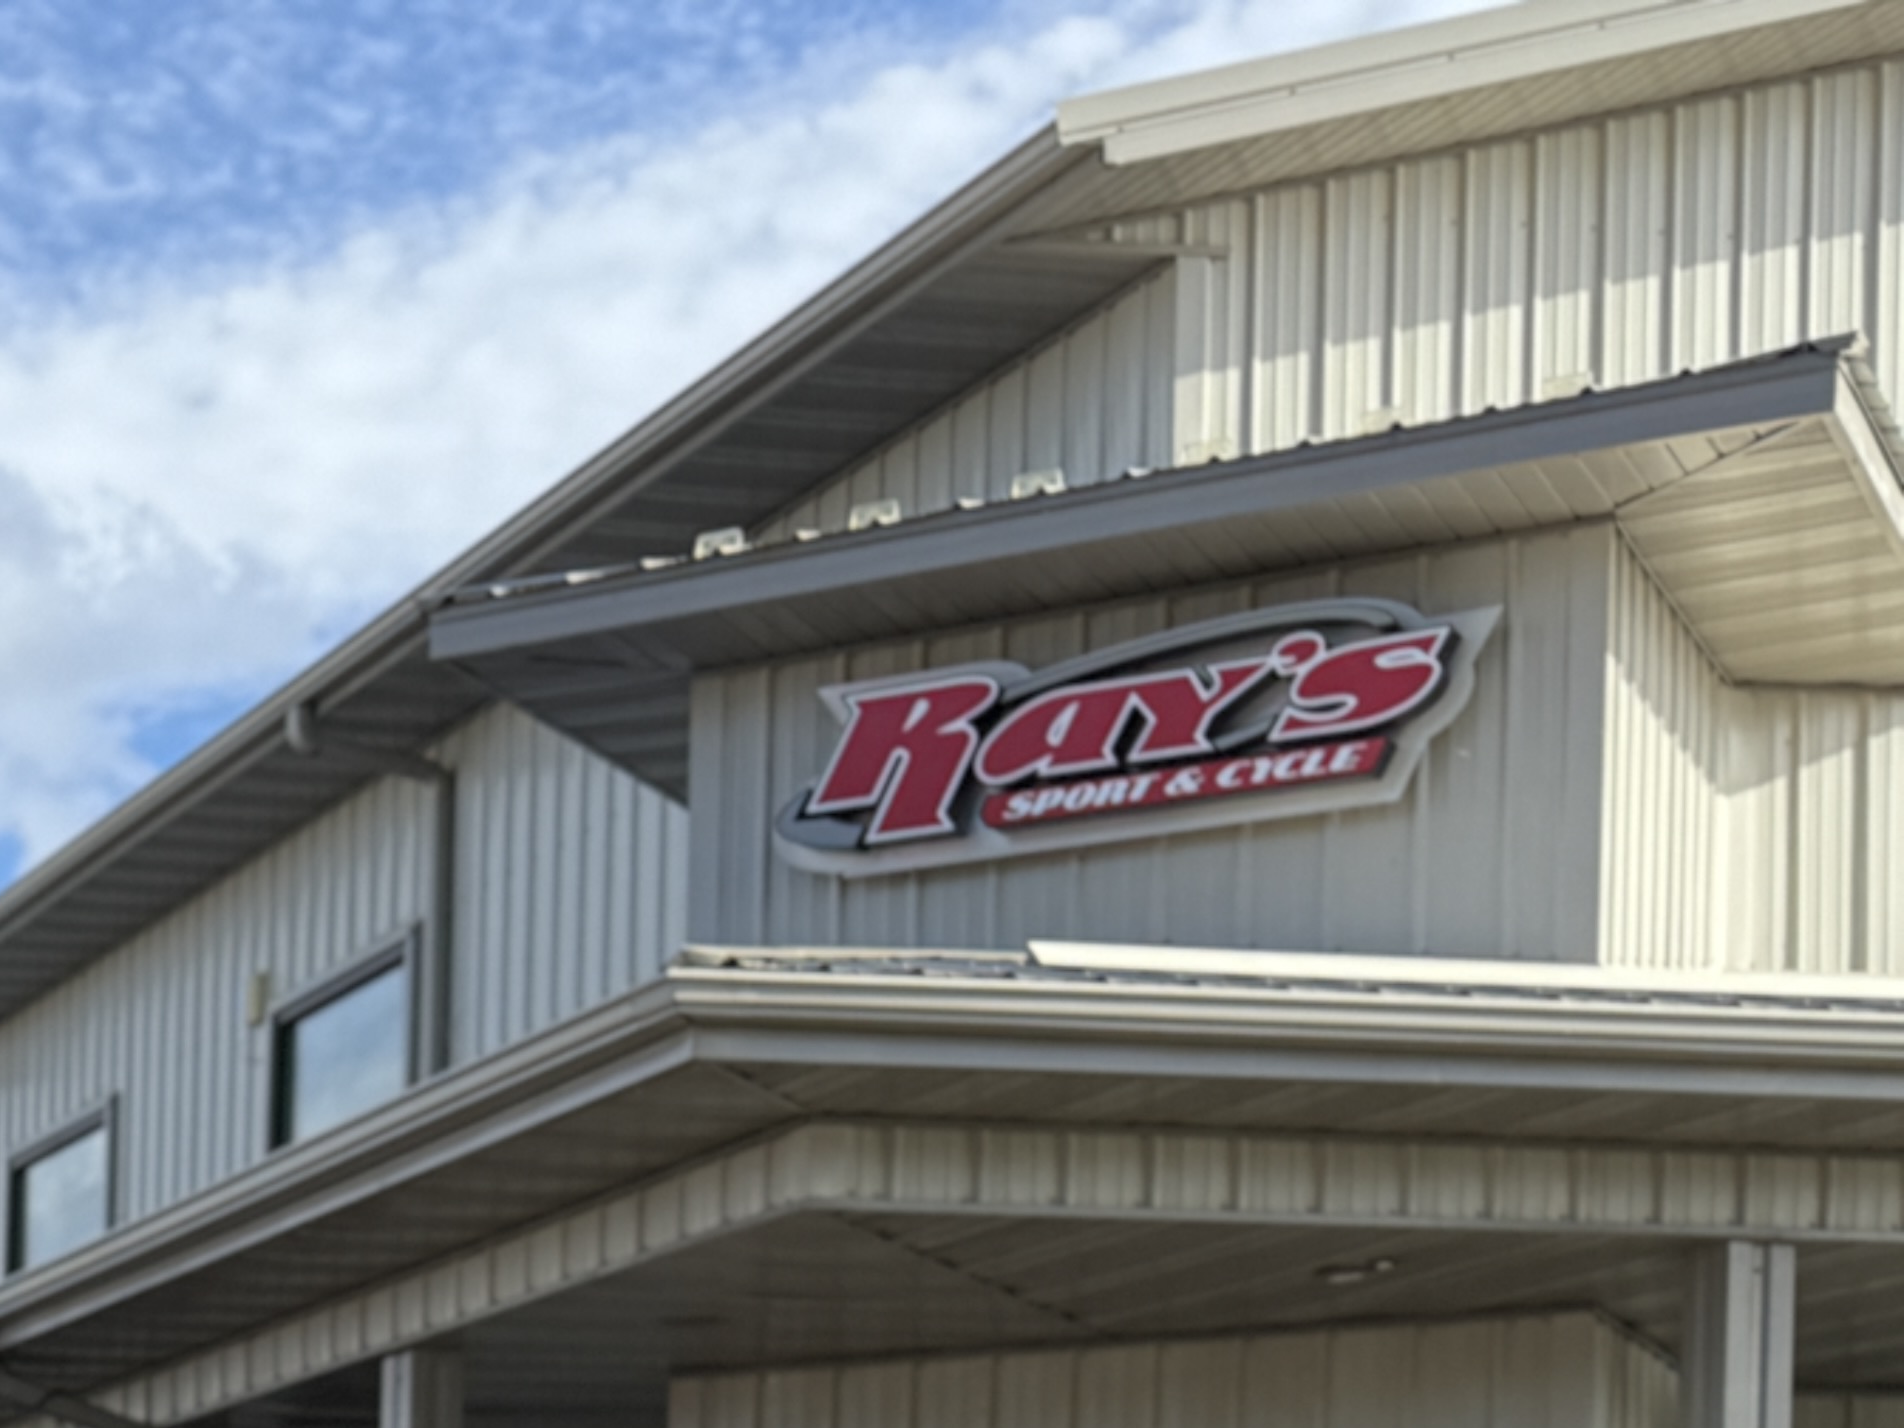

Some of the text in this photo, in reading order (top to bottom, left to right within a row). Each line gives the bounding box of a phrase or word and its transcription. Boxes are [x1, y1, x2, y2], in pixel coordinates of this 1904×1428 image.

[1001, 742, 1364, 823] SPORT & CYCLE
